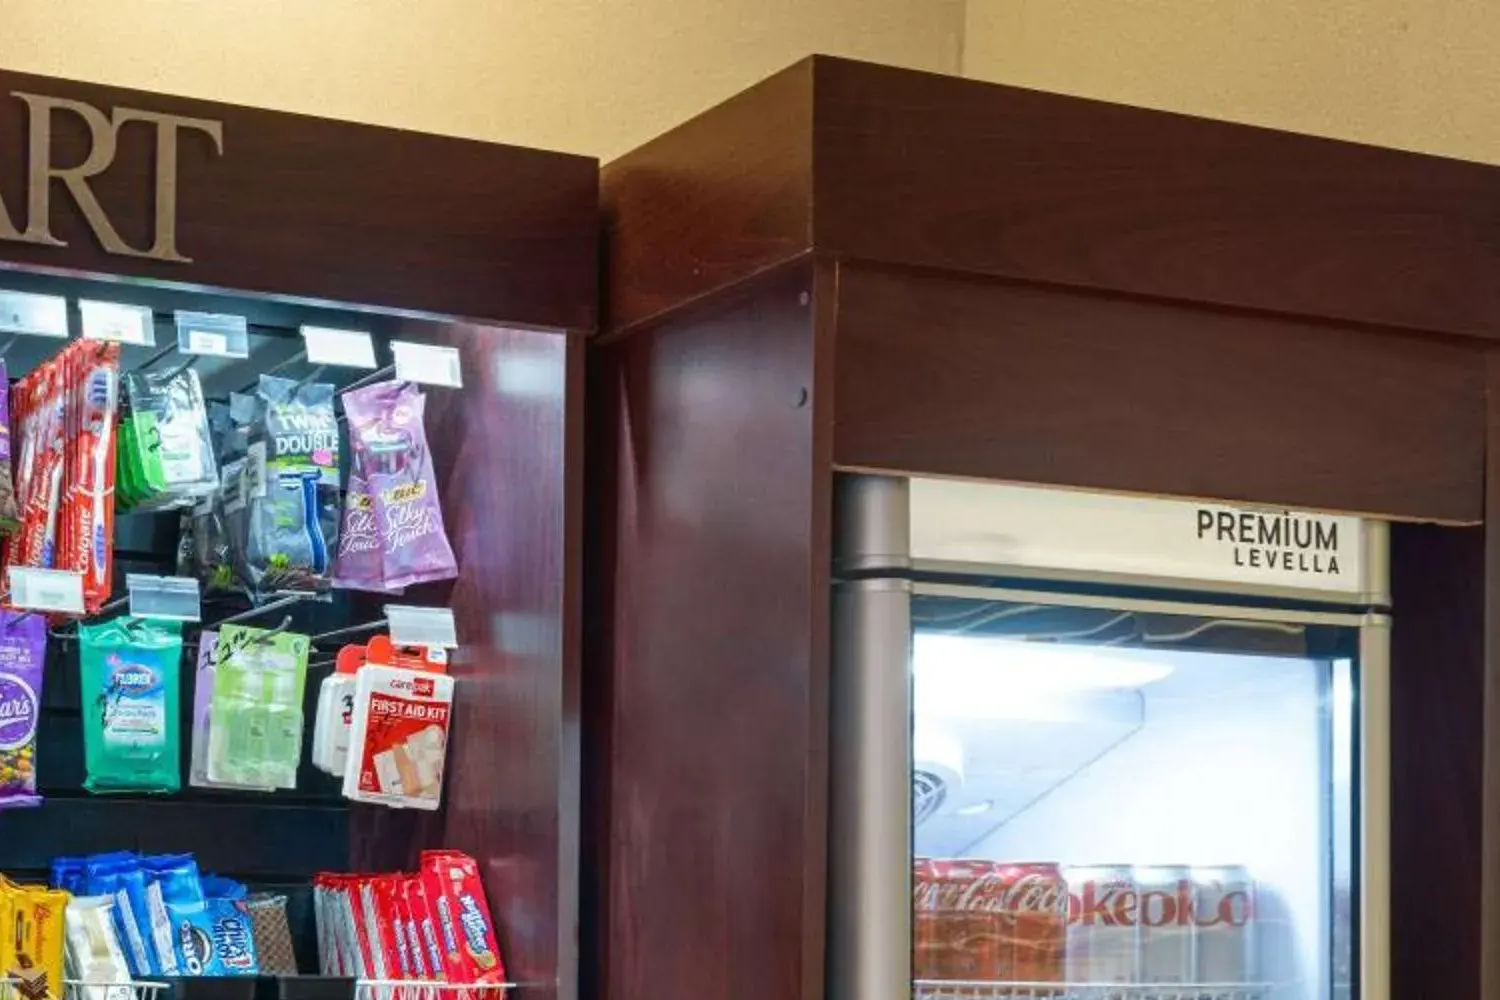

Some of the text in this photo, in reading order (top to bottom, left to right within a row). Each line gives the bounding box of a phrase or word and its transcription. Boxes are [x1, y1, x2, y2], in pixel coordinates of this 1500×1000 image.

[276, 433, 340, 455] DOUBLE
[1233, 547, 1341, 575] LEVELLA
[371, 698, 448, 722] FIRST AID KIT
